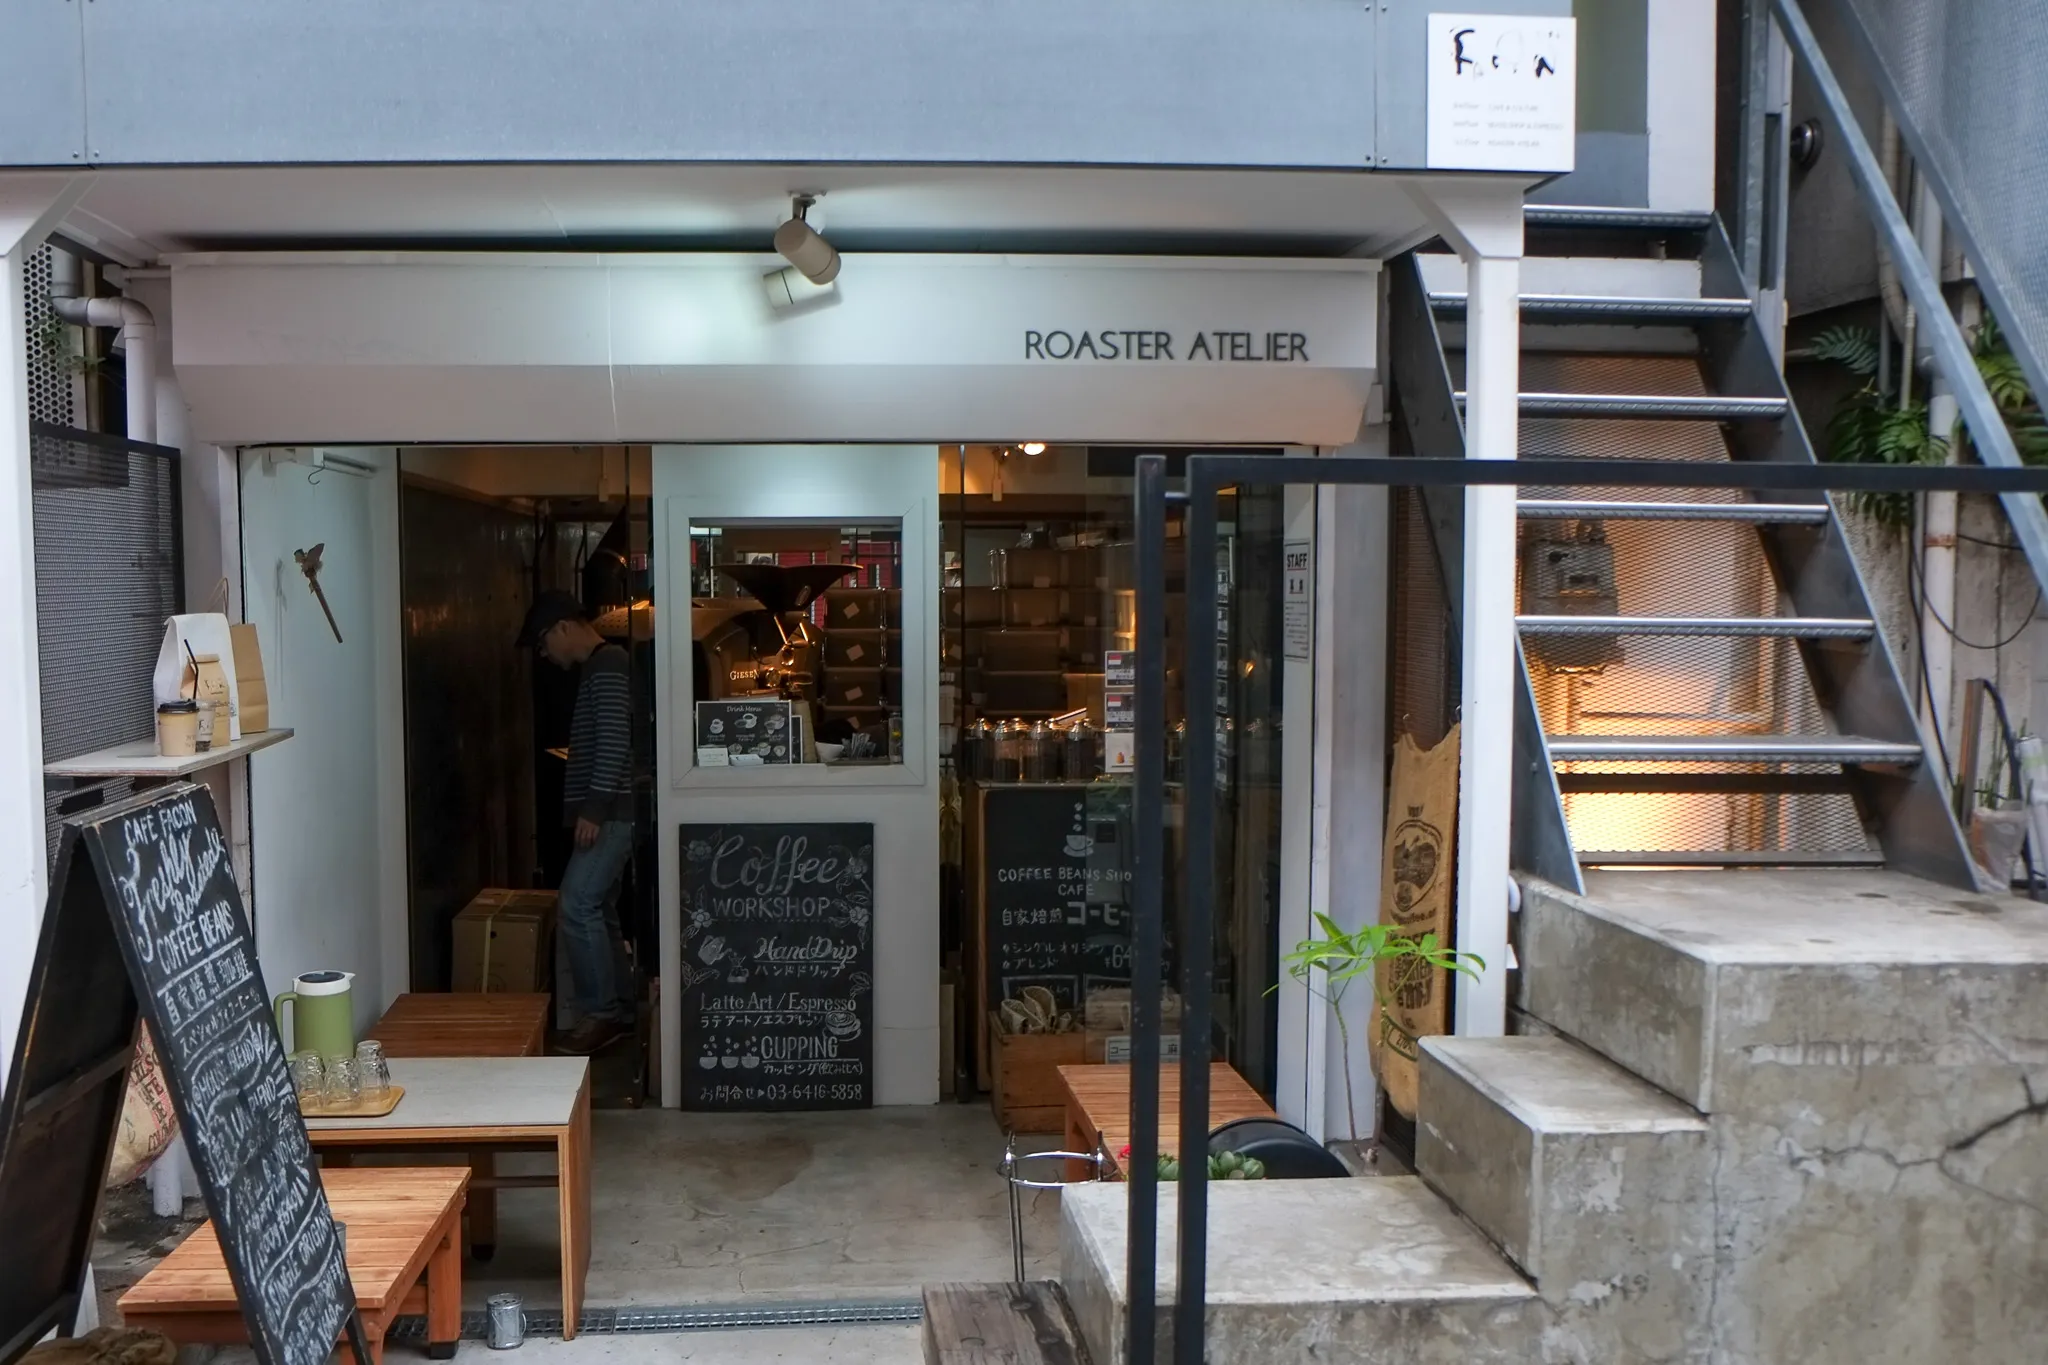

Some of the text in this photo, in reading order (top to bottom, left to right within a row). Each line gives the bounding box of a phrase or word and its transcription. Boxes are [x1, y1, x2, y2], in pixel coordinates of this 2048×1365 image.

[1025, 330, 1310, 362] ROASTER ATELIER
[1286, 553, 1307, 568] STAFF
[729, 670, 760, 681] GIESEN
[158, 799, 197, 839] FACON
[710, 834, 845, 895] Coffee
[998, 867, 1052, 882] COFFEE
[1058, 867, 1100, 882] BEANS
[1057, 884, 1095, 896] CAFE
[712, 896, 831, 919] WORKSHOP
[156, 900, 236, 974] COFFEE BEANS
[754, 963, 845, 978] ハンドドリップ
[700, 992, 744, 1011] Latte
[749, 992, 773, 1010] Art
[788, 991, 857, 1019] Espresso
[760, 1035, 839, 1060] CUPPING
[700, 1083, 863, 1103] お問合せ 03-6416-5858
[266, 1250, 302, 1318] SINGLE
